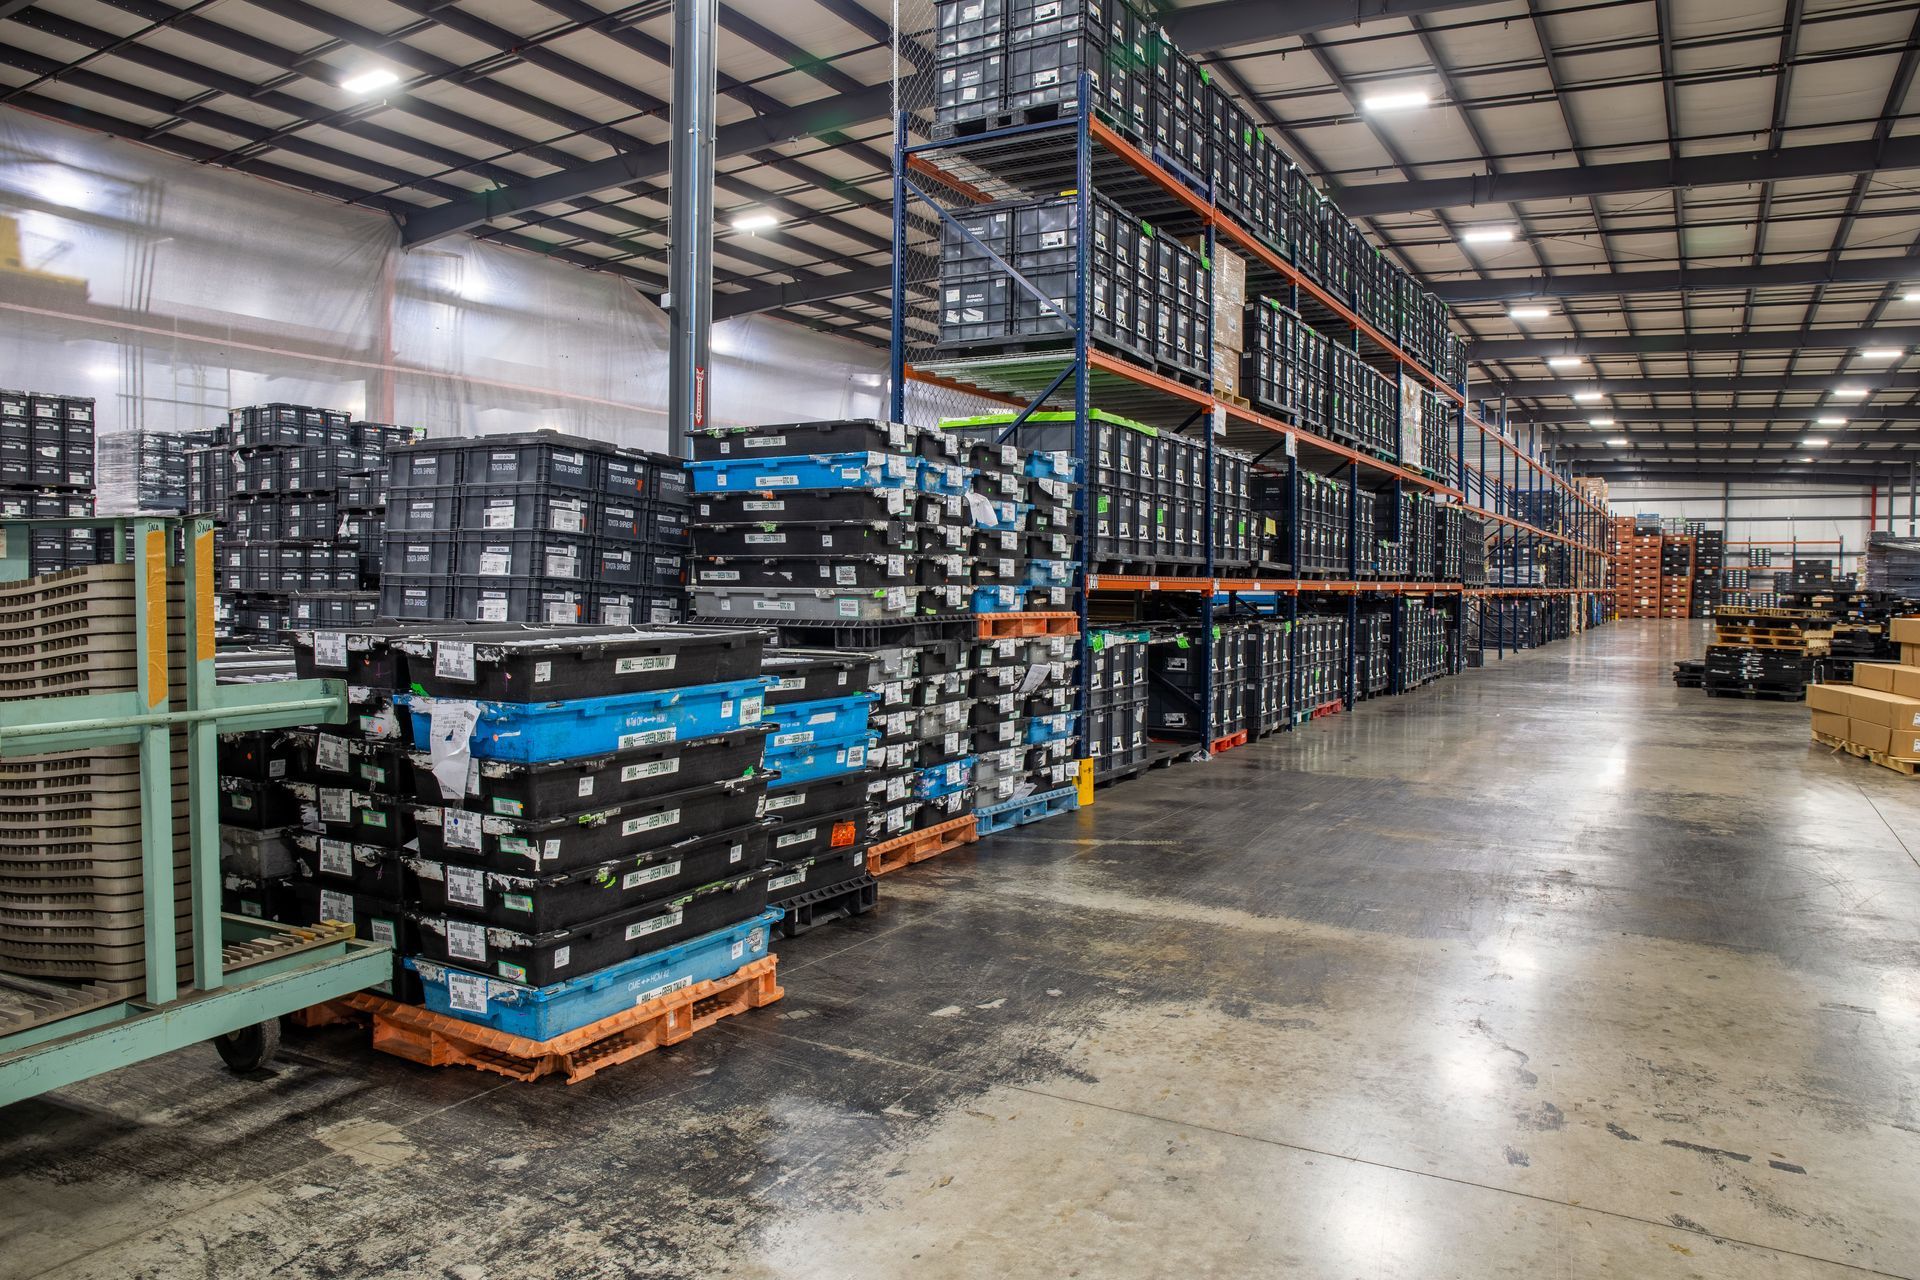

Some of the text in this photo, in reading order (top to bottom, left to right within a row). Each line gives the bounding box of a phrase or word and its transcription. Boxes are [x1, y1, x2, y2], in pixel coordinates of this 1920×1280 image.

[555, 463, 582, 475] TOYOTA SHIPMENT
[621, 660, 631, 671] HMA
[643, 658, 654, 669] GREEN
[655, 657, 664, 668] TOKAI
[624, 736, 633, 747] HMA
[645, 732, 655, 744] GREEN
[627, 767, 637, 779] HMA
[648, 763, 659, 775] GREEN
[660, 762, 669, 773] TOKAI
[628, 821, 638, 832] HMA
[649, 816, 660, 827] GREEN
[661, 815, 670, 825] TOKAI
[629, 865, 676, 884] HMA GREEN TOKAI 01
[631, 925, 641, 937] HMA
[651, 919, 663, 931] GREEN
[663, 916, 673, 927] TOKAI
[651, 972, 663, 983] HCM
